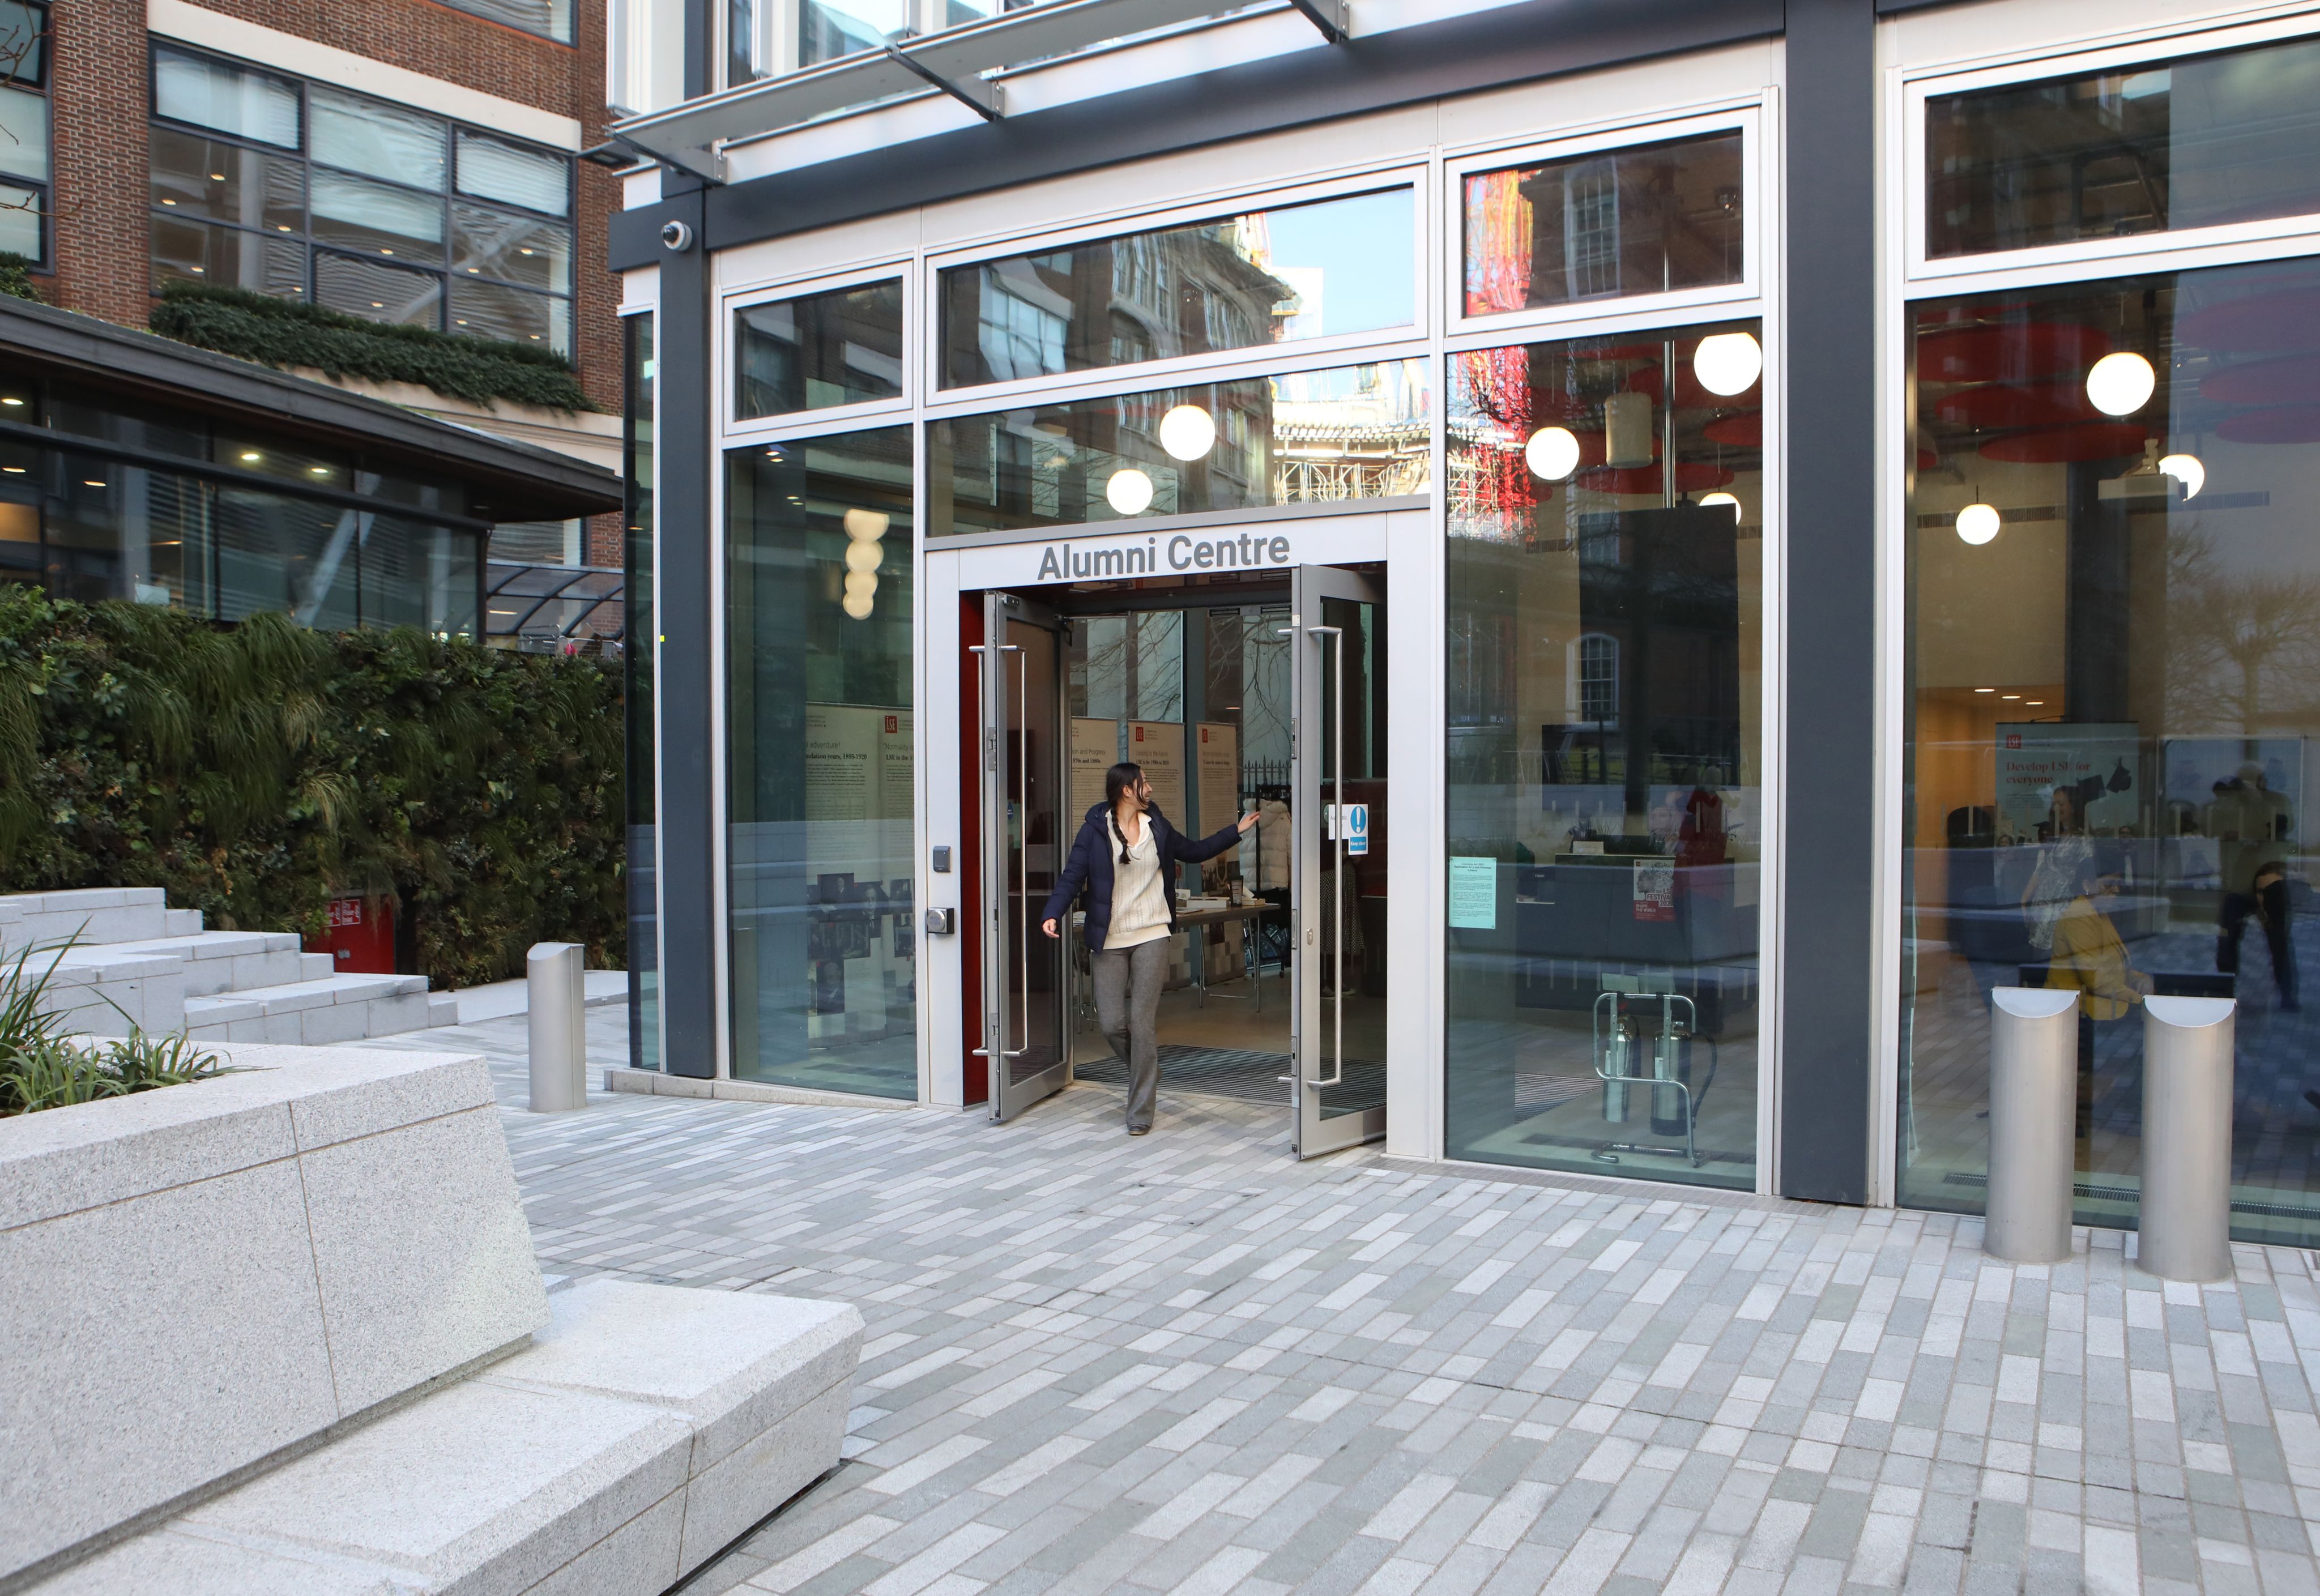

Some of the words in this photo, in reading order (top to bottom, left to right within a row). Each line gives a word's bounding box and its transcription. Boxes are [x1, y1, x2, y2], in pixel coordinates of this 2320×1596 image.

[1037, 536, 1155, 581] Alumni
[1168, 533, 1290, 570] Centre
[2006, 761, 2048, 773] Develop
[2052, 761, 2073, 771] LSE
[2075, 761, 2091, 771] for
[2006, 776, 2053, 786] everyone
